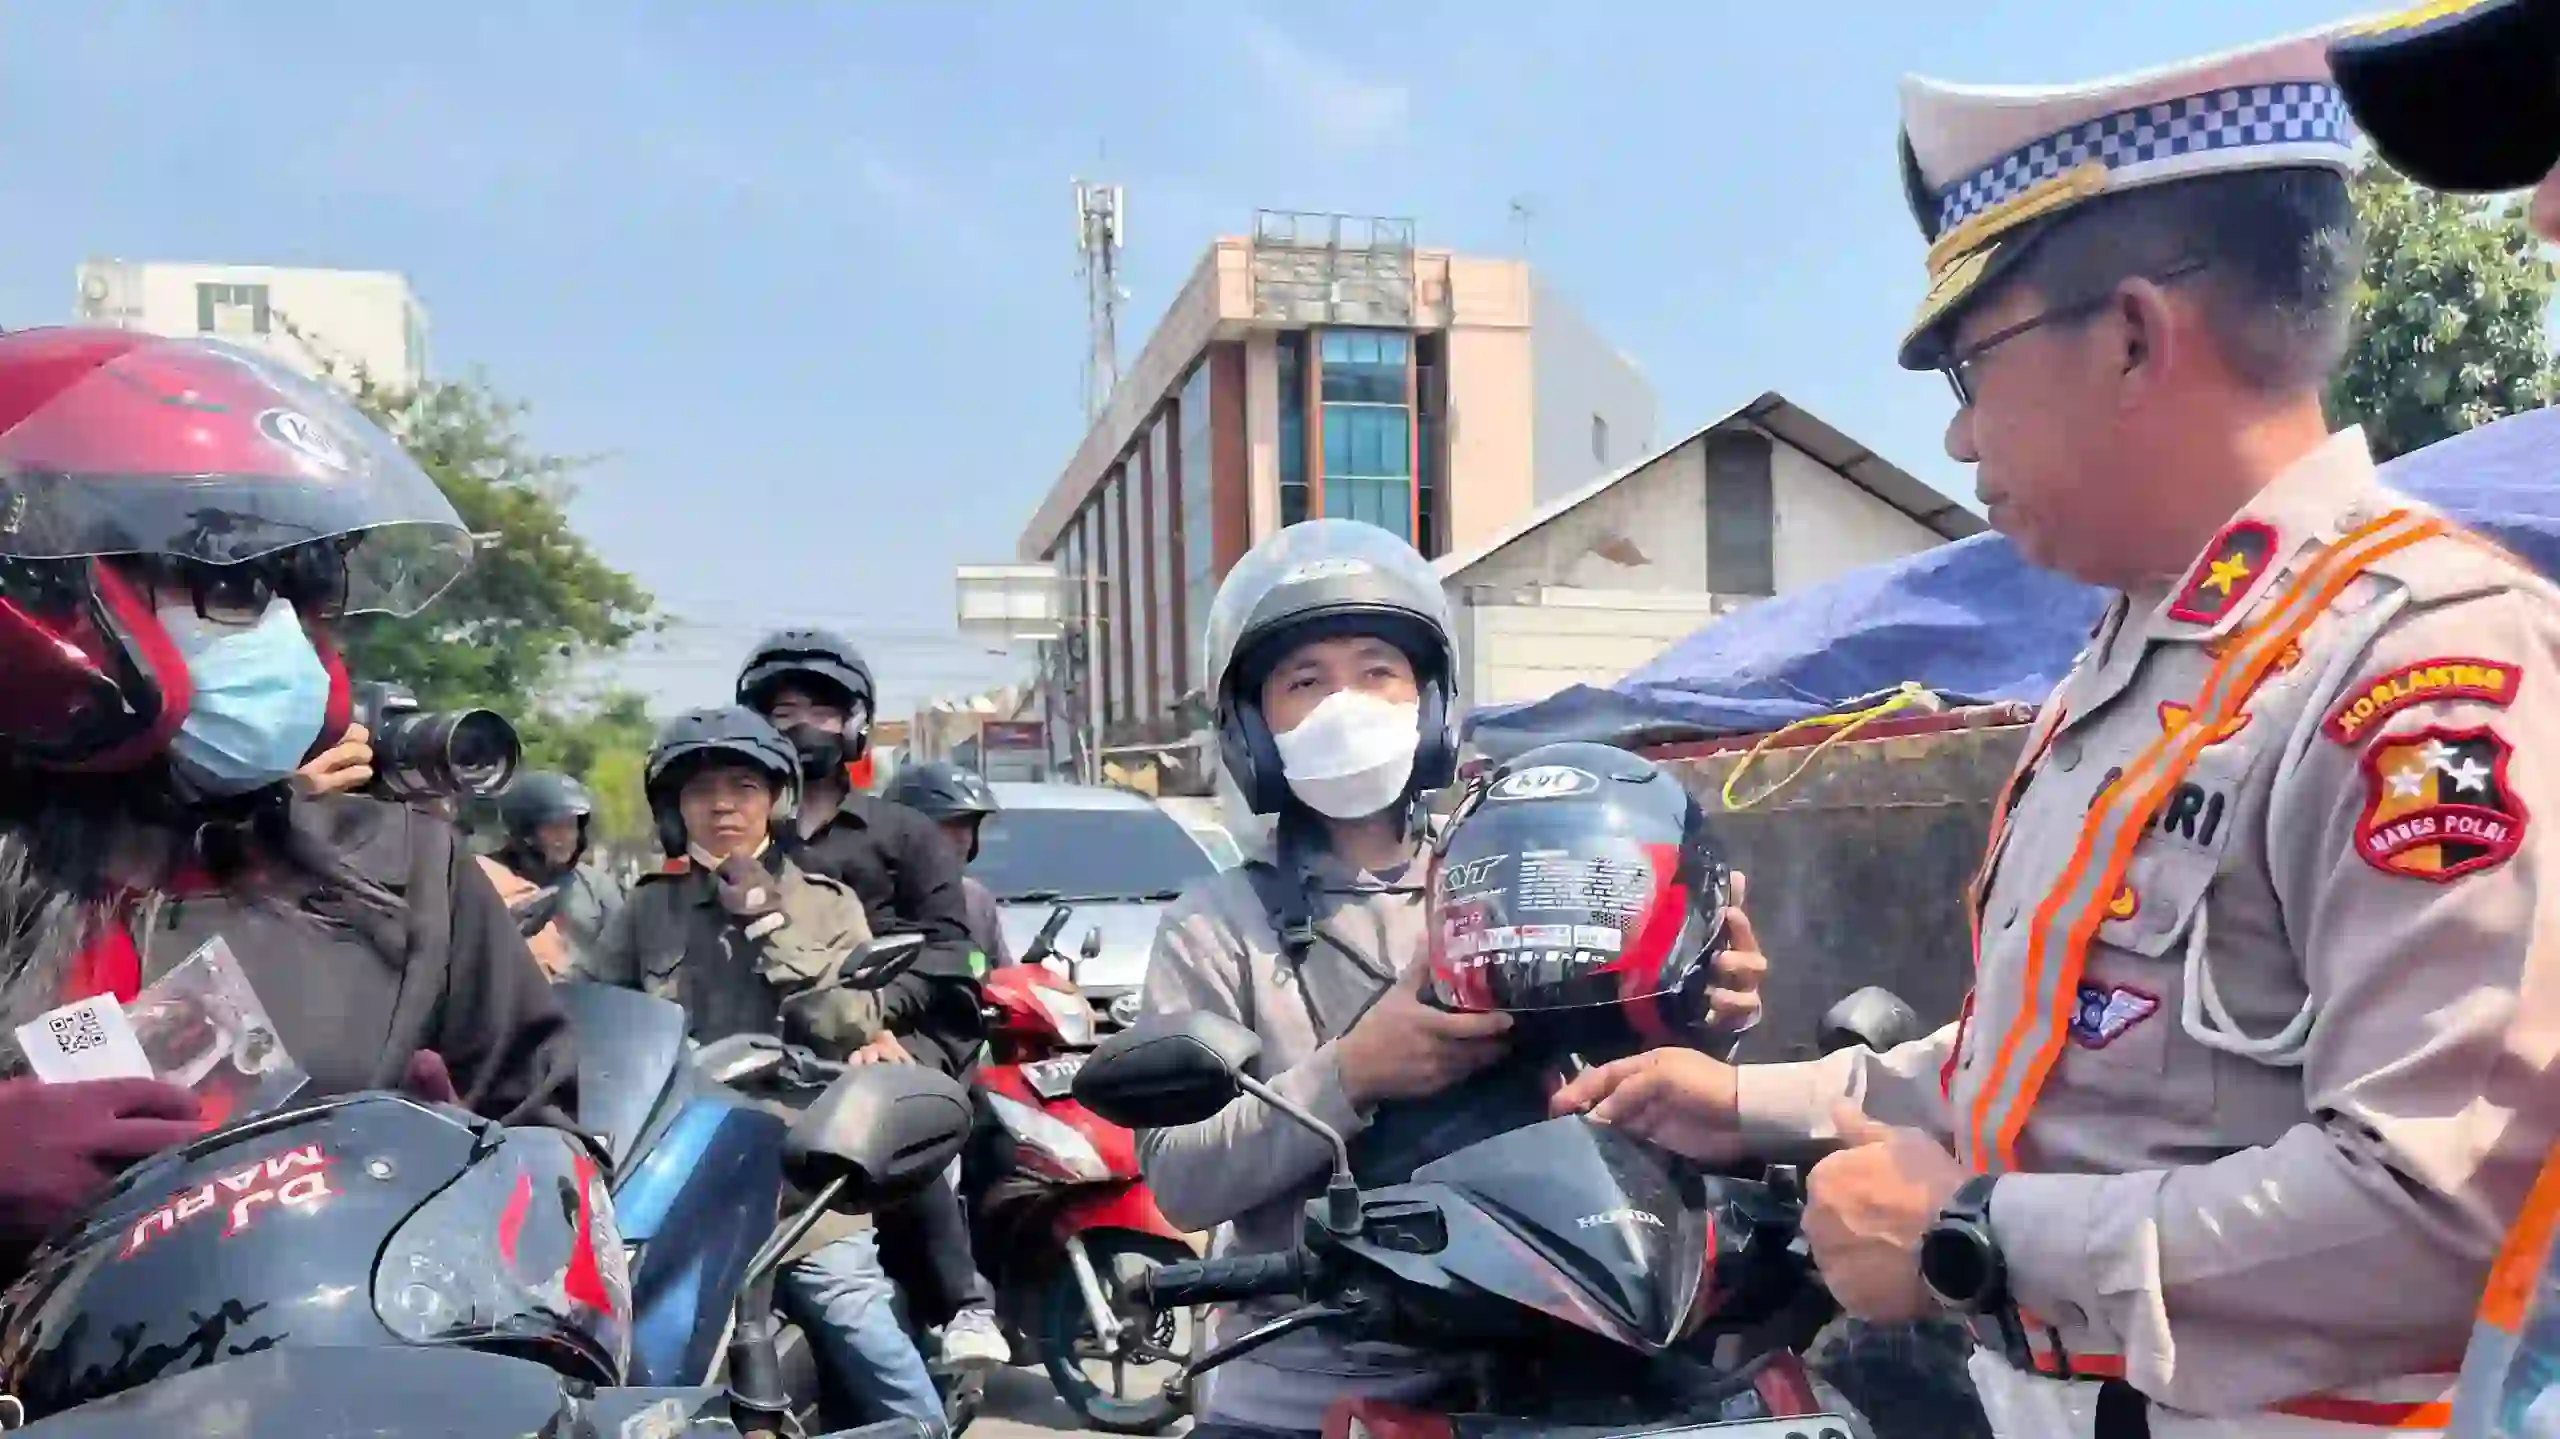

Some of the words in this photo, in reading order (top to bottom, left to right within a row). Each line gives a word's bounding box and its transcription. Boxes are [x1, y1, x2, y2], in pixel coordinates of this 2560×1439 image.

[2445, 815, 2509, 842] POLRI
[121, 1143, 330, 1258] MARU
[226, 1171, 336, 1238] DJ
